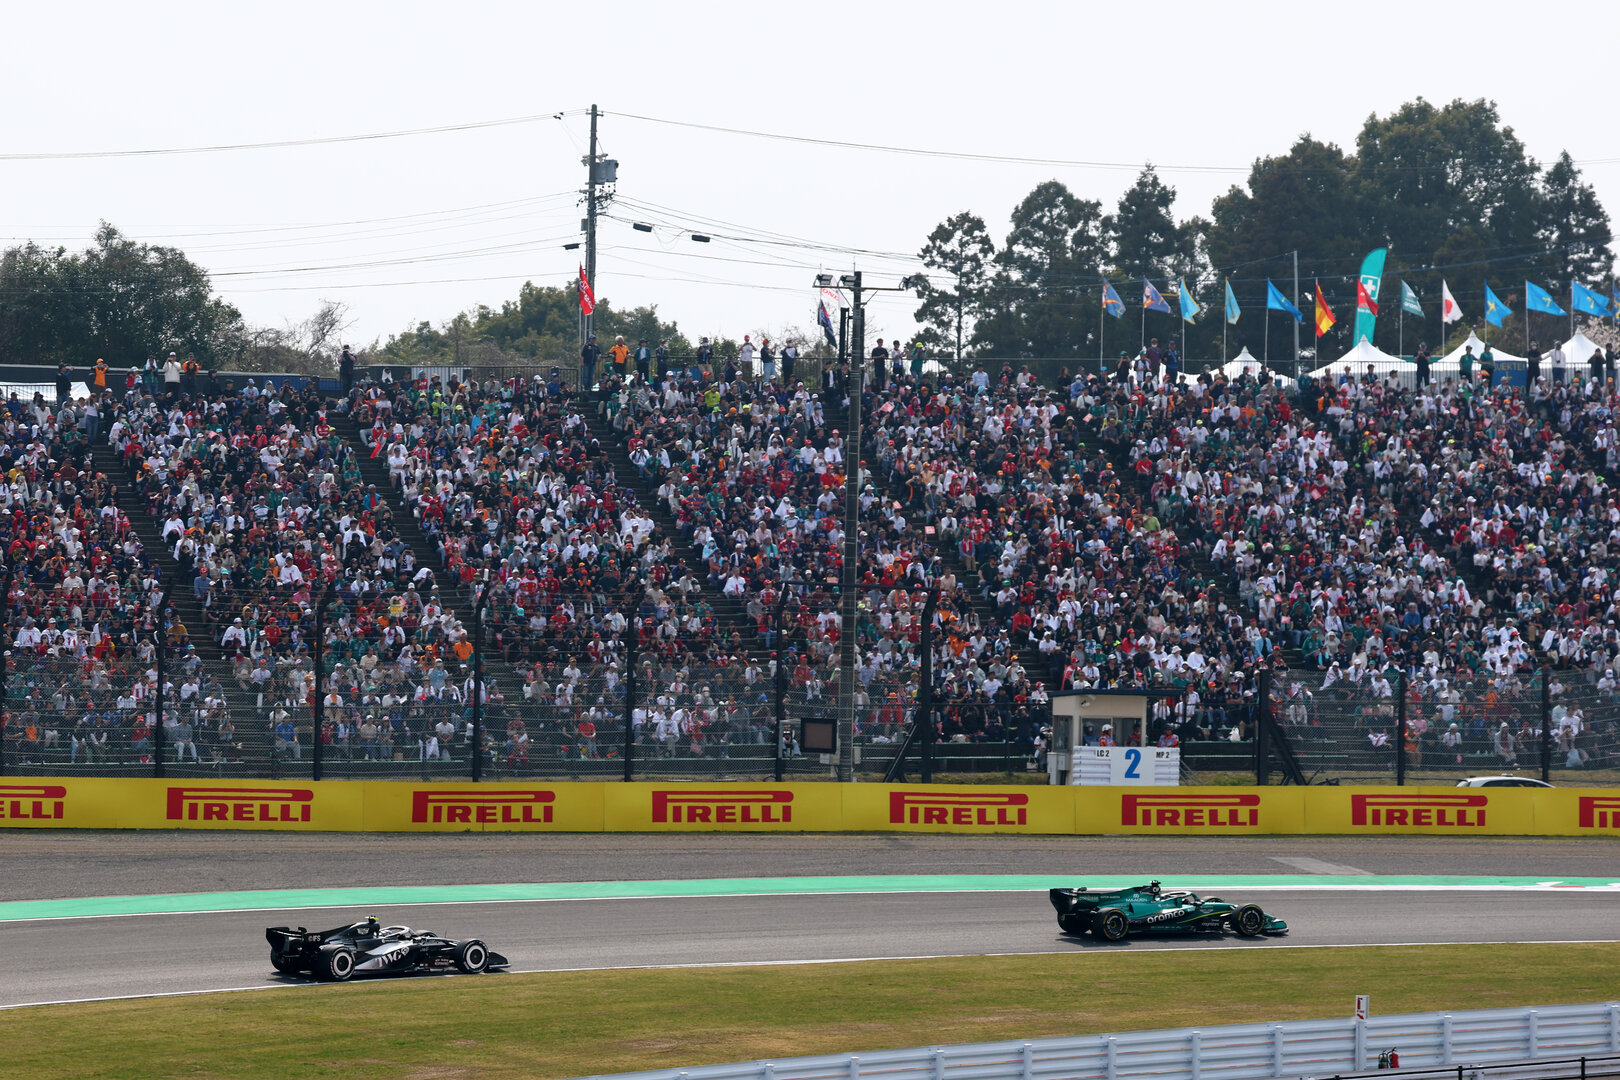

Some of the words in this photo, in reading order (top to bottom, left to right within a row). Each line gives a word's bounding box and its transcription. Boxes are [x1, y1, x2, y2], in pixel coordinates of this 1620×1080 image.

[1124, 749, 1142, 779] 2
[167, 788, 313, 821] PIRELLI
[412, 791, 555, 823] PIRELLI
[653, 791, 793, 822] PIRELLI
[890, 792, 1028, 824] PIRELLI
[1122, 795, 1260, 825] PIRELLI
[1352, 795, 1487, 826] PIRELLI
[1147, 910, 1185, 924] aramco
